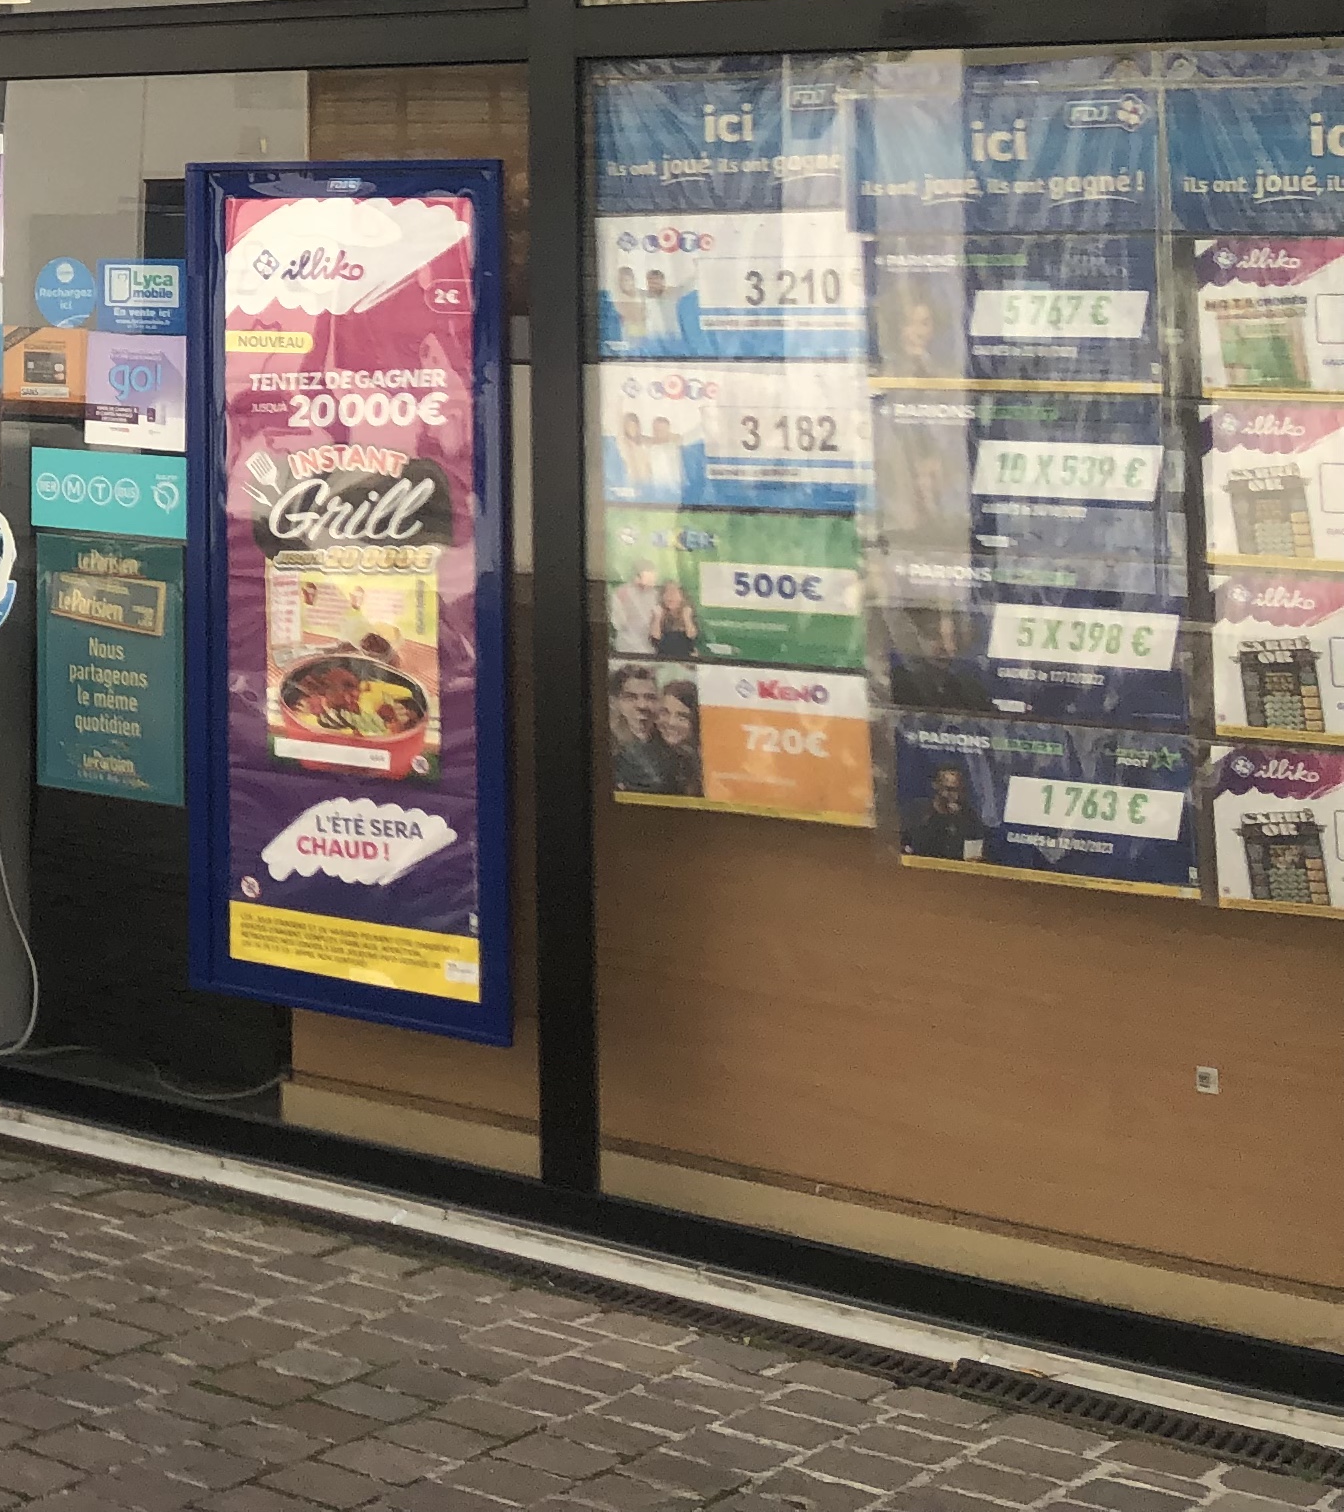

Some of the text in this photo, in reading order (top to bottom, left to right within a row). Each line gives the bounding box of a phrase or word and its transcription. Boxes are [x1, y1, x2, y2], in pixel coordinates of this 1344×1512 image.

[703, 103, 754, 143] ici
[970, 118, 1029, 162] ici
[642, 226, 714, 253] LOTO
[281, 246, 364, 281] illiko
[1236, 247, 1301, 268] illiko
[133, 270, 174, 289] Lyca
[39, 287, 93, 299] Rechargez
[133, 288, 173, 299] mobile
[433, 289, 461, 304] 2€
[1090, 295, 1112, 326] €
[237, 335, 305, 349] NOUVEAU
[249, 368, 448, 392] TENTEZ DE GAGNER
[647, 374, 719, 400] LOTO
[1241, 414, 1306, 436] illiko
[287, 444, 411, 480] INSTANT
[1035, 455, 1051, 485] X
[1124, 456, 1147, 488] €
[66, 480, 81, 496] M
[94, 483, 106, 499] T
[268, 477, 435, 540] Grill
[733, 571, 824, 602] 500€
[1251, 586, 1316, 610] illiko
[89, 637, 125, 661] Nous
[1016, 617, 1154, 657] 5 X 398 €
[69, 662, 148, 689] partageons
[77, 684, 138, 712] le même
[1253, 759, 1321, 783] illiko
[1041, 784, 1150, 825] 1 763 €
[315, 811, 424, 839] L'ÉTÉ SERA
[296, 836, 379, 860] CHAUD
